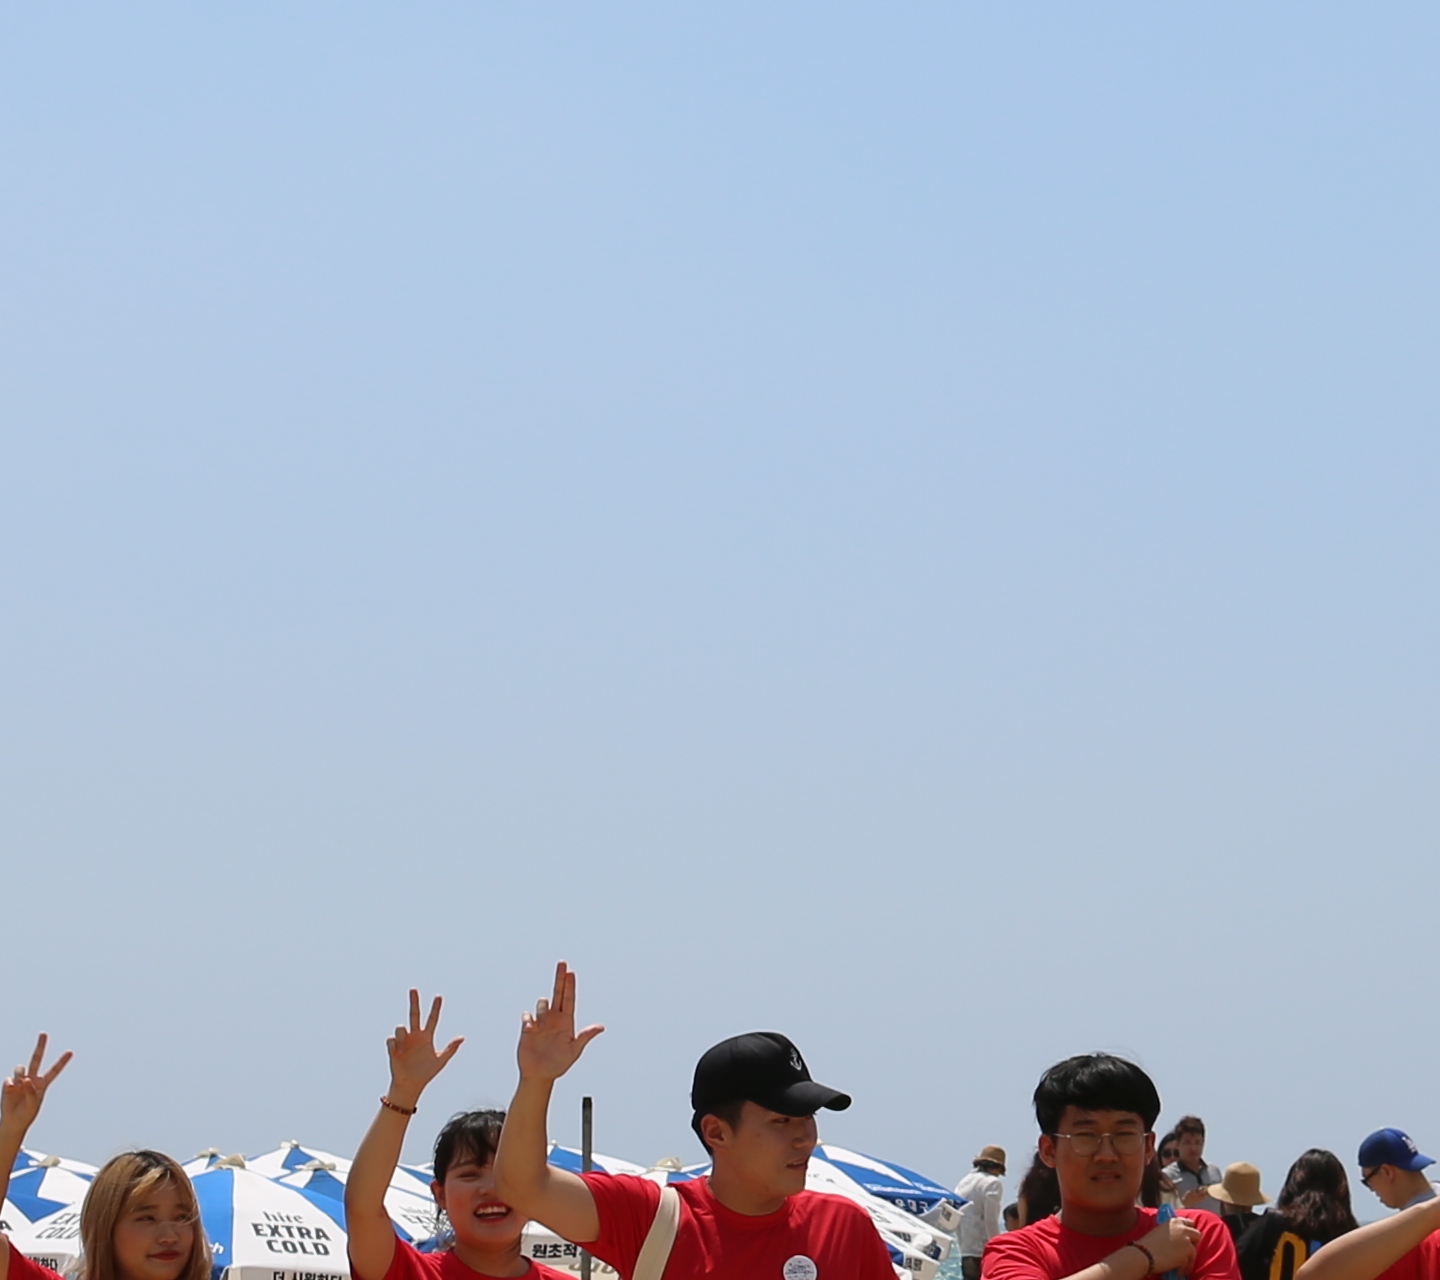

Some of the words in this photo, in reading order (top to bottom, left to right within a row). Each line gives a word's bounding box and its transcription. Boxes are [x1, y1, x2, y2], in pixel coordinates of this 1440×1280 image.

[251, 1223, 331, 1242] EXTRA
[266, 1239, 330, 1256] COLD
[532, 1243, 578, 1259] 원초적
